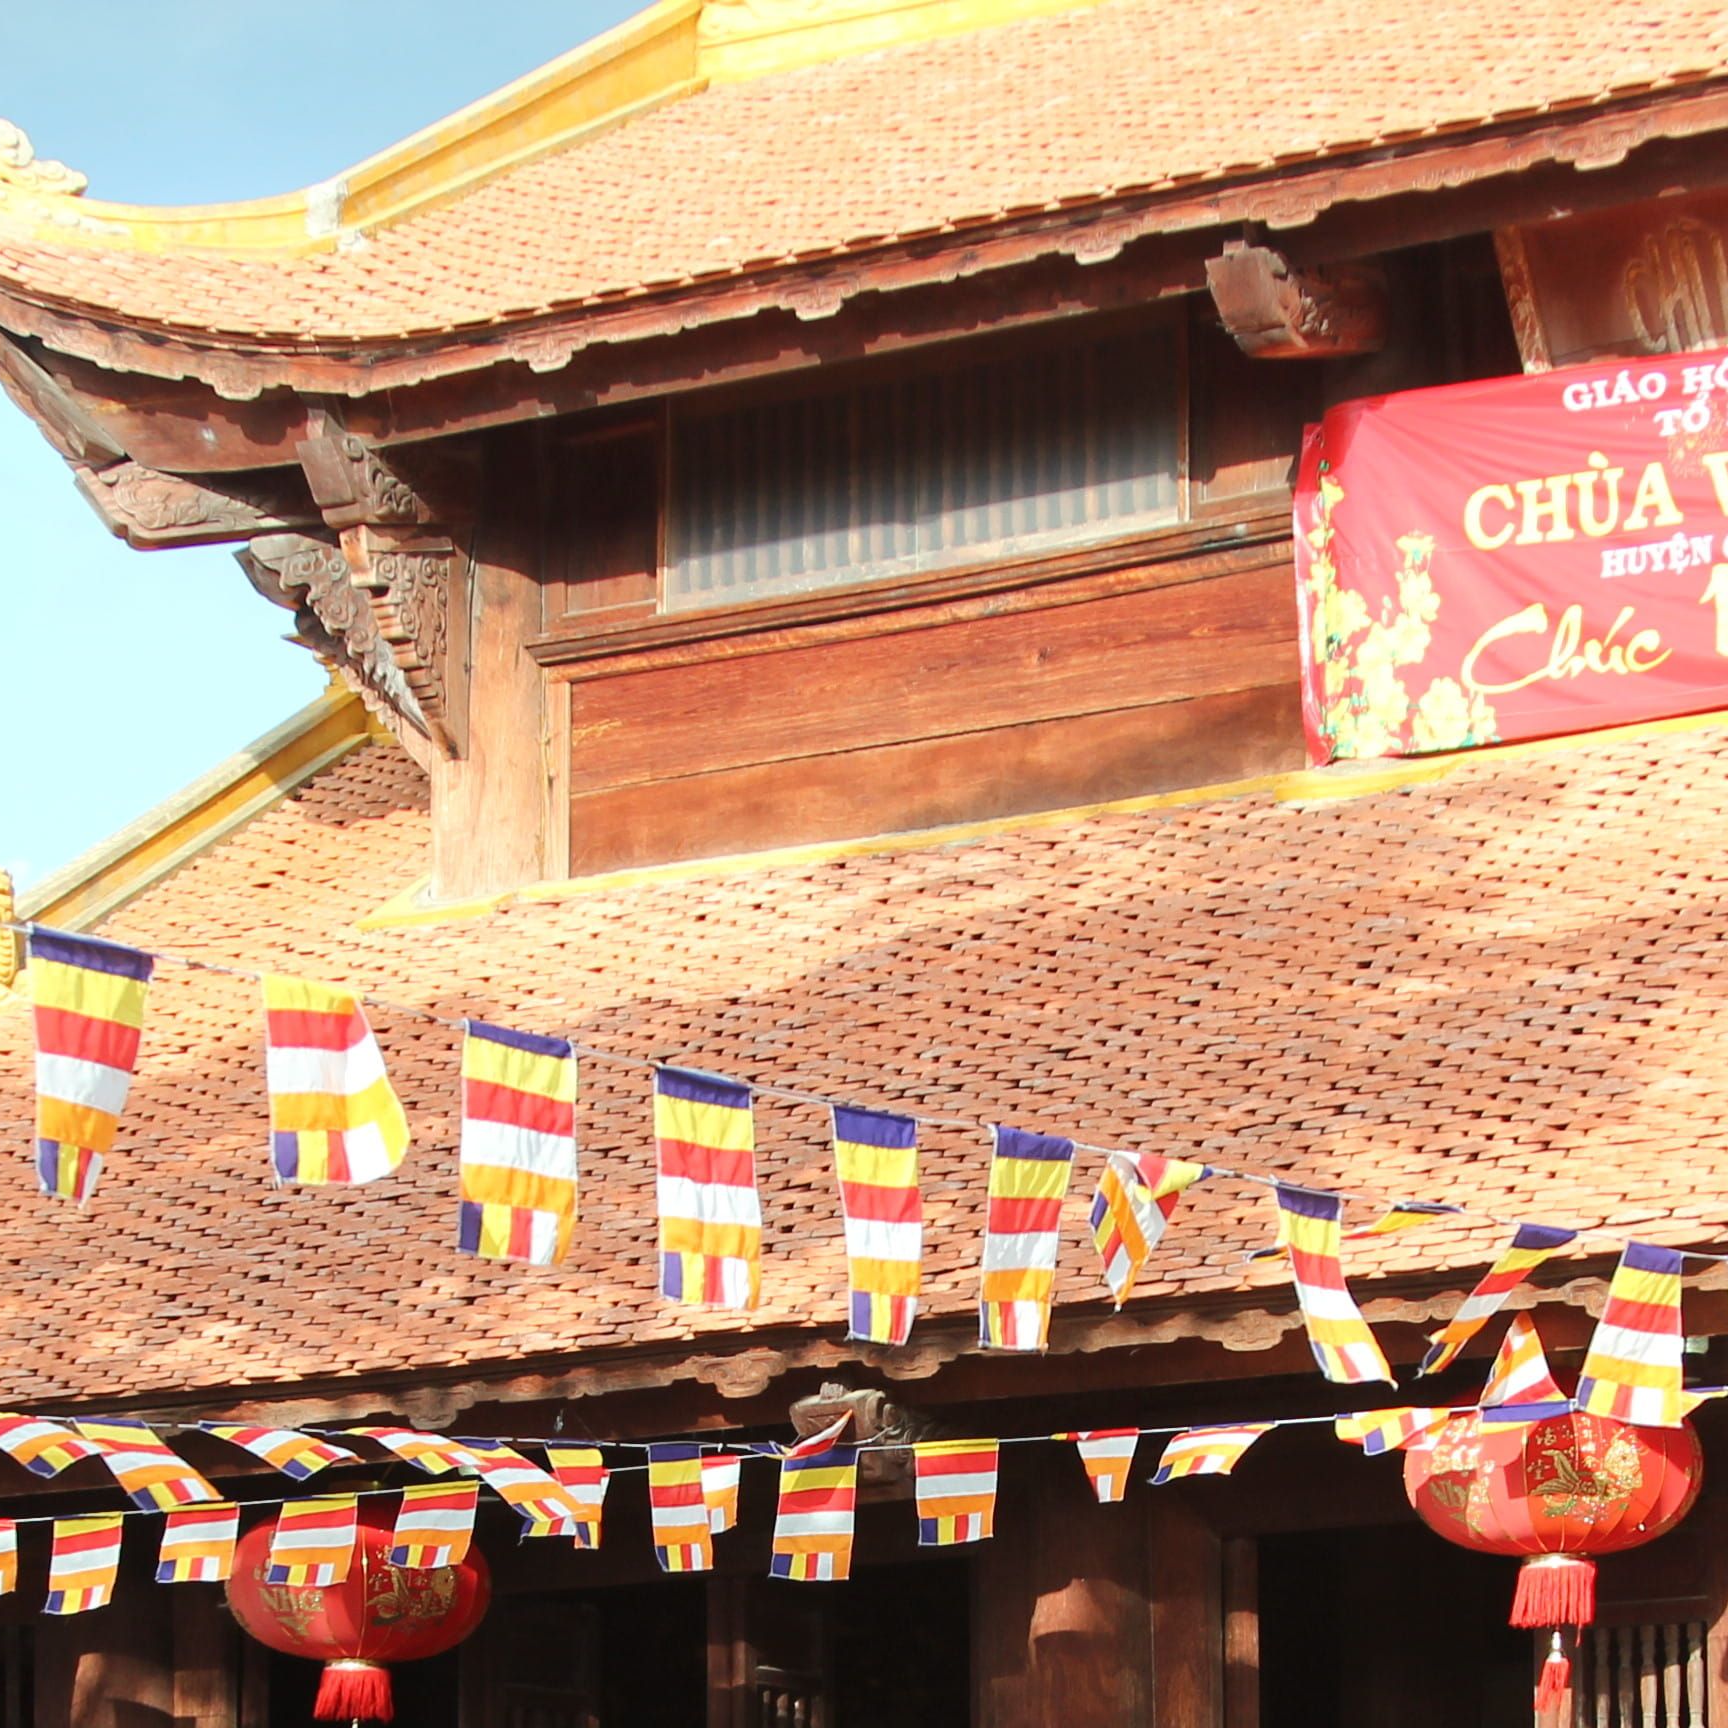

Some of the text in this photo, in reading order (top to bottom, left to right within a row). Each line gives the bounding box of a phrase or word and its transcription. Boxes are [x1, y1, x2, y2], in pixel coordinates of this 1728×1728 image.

[1562, 370, 1667, 412] GIÁO
[1463, 450, 1684, 551] CHÙA
[1600, 531, 1714, 578] HUYỆN
[1461, 602, 1672, 694] Chúc
